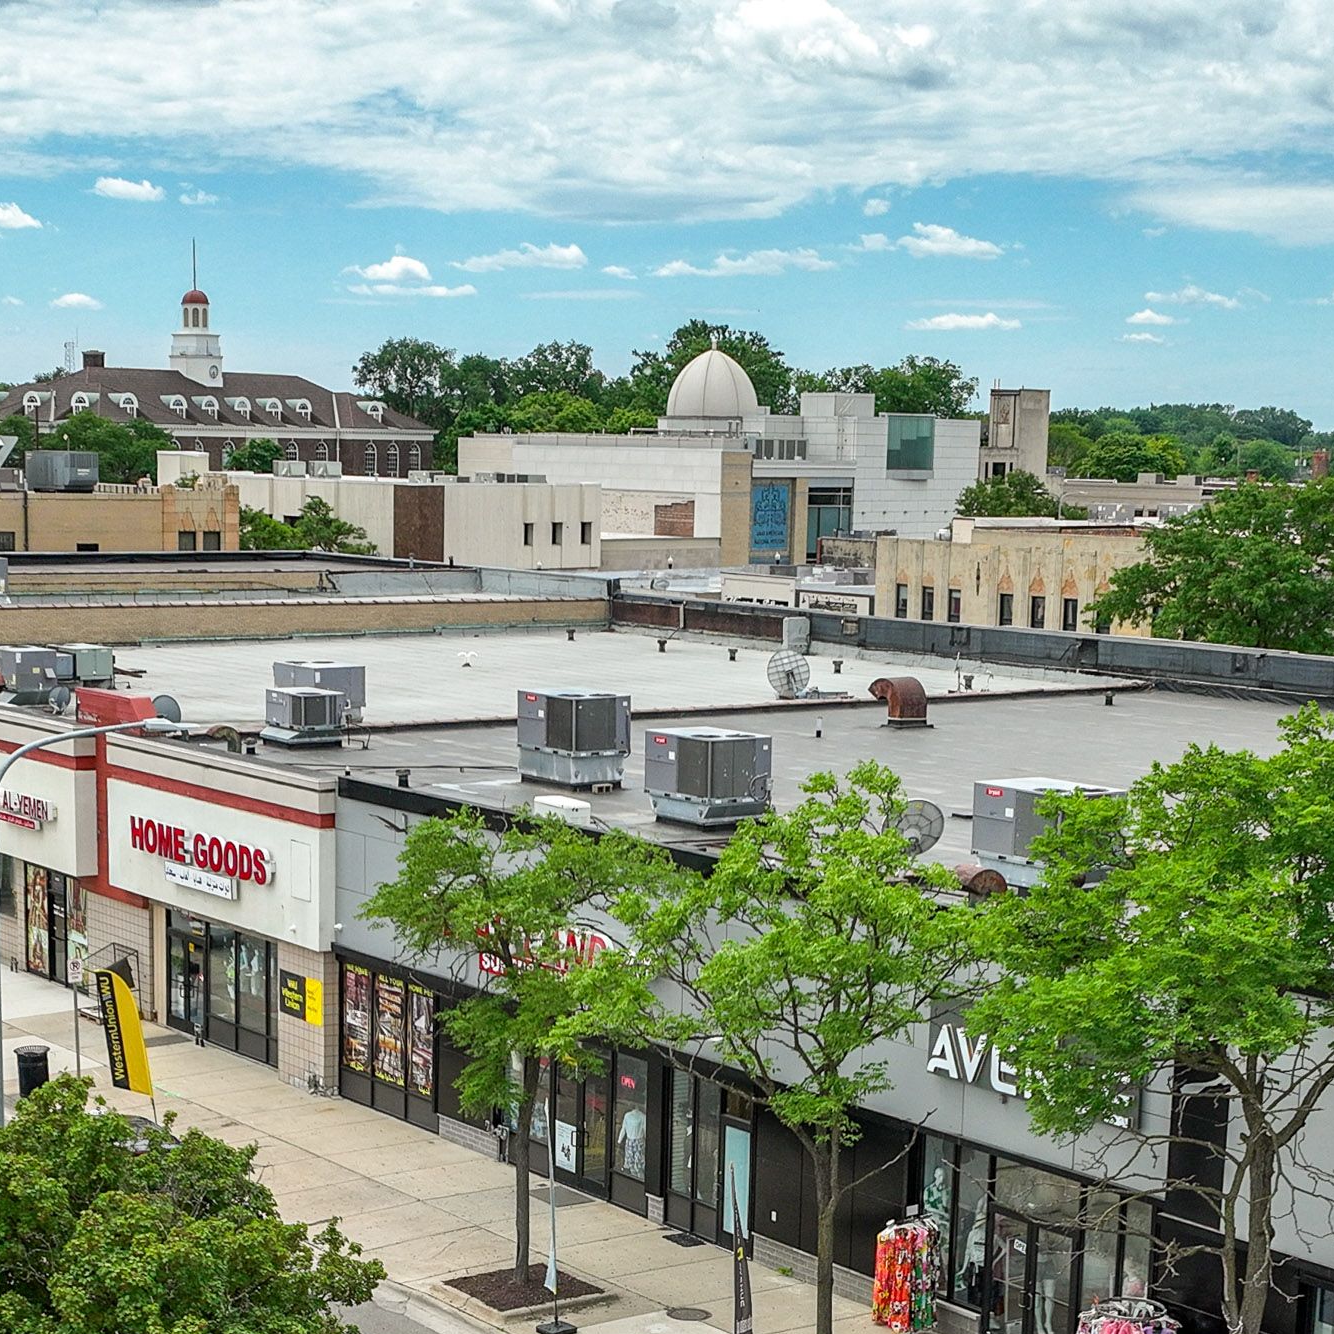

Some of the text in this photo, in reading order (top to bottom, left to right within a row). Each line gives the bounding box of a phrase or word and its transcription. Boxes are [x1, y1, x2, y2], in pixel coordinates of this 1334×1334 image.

[2, 789, 49, 821] AL-YEMEN
[130, 815, 267, 886] HOME GOODS
[378, 974, 404, 987] ALL YOUR
[282, 986, 304, 1003] Western
[408, 983, 423, 995] HOME
[285, 997, 301, 1011] Union
[620, 1075, 636, 1089] OPEN
